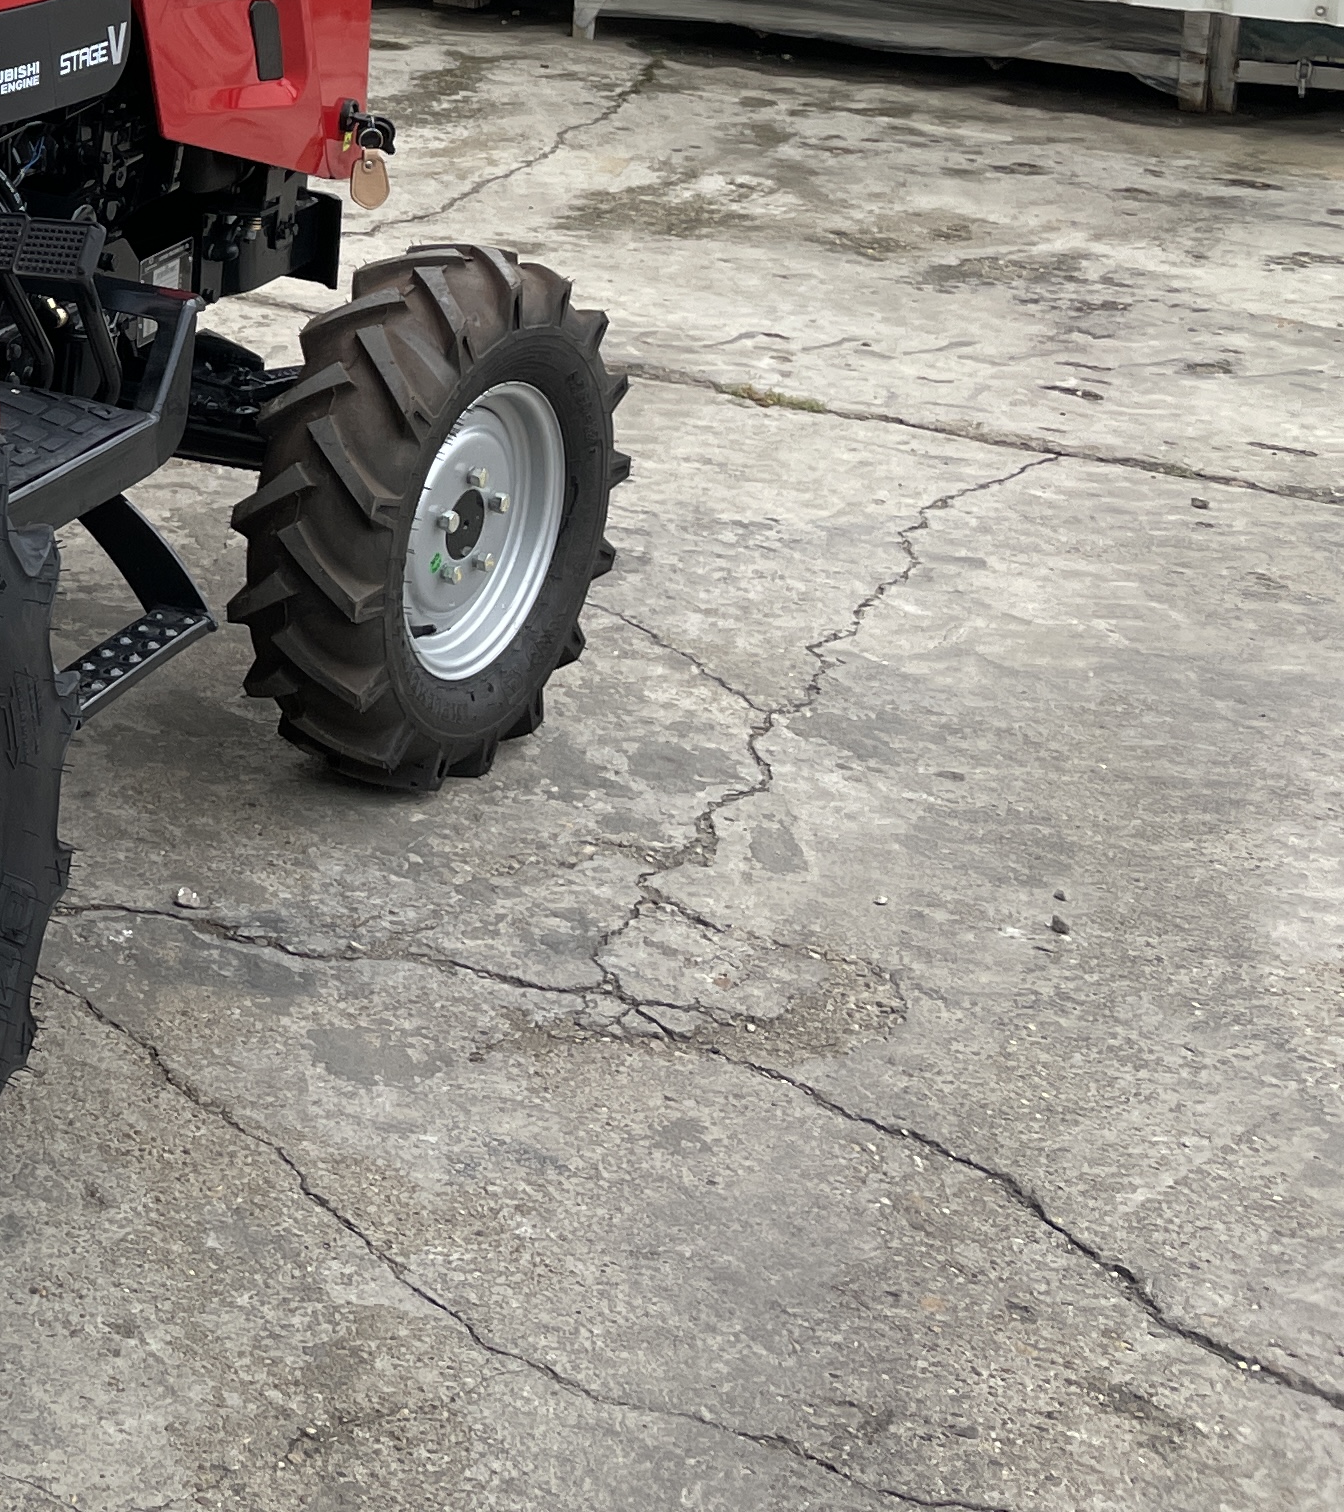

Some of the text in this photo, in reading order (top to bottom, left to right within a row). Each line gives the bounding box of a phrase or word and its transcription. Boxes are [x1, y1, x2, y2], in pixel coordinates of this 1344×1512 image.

[60, 21, 127, 76] STAGE V
[0, 75, 40, 95] ENGINE
